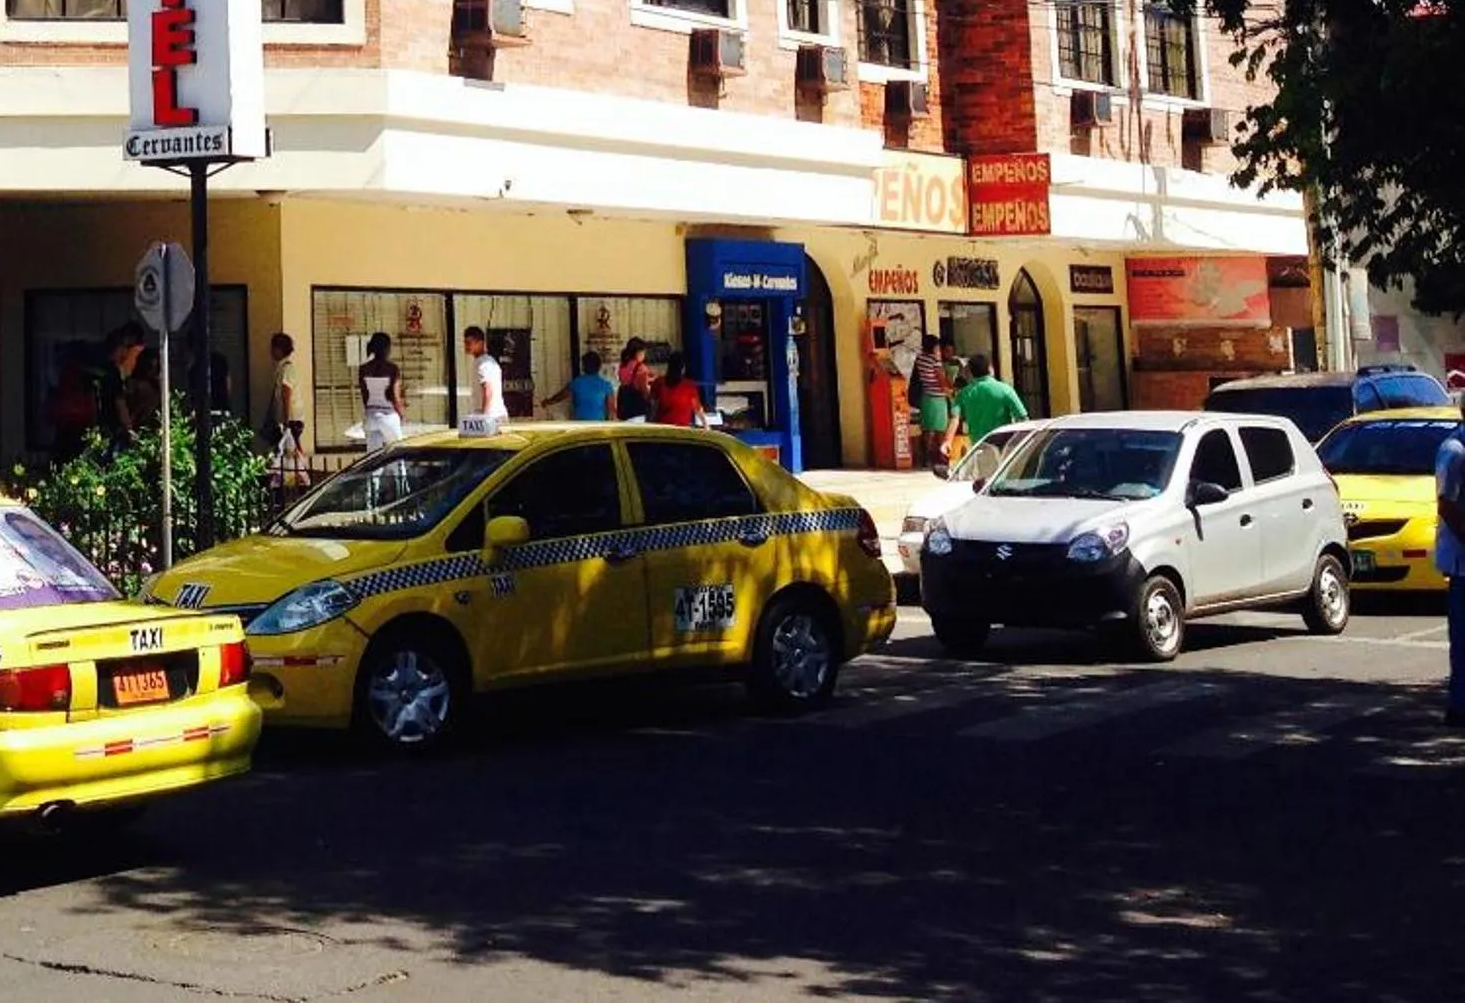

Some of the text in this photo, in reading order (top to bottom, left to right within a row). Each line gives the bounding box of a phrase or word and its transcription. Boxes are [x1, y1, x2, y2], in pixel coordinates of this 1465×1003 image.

[125, 130, 224, 157] Cervantes
[971, 158, 1049, 183] EMPEÑOS
[874, 161, 965, 227] EÑOS
[971, 199, 1050, 233] EMPEÑOS
[867, 263, 919, 295] EMPEÑOS
[463, 419, 486, 432] TAXI
[175, 583, 211, 608] TAXI
[130, 627, 163, 651] TAXI
